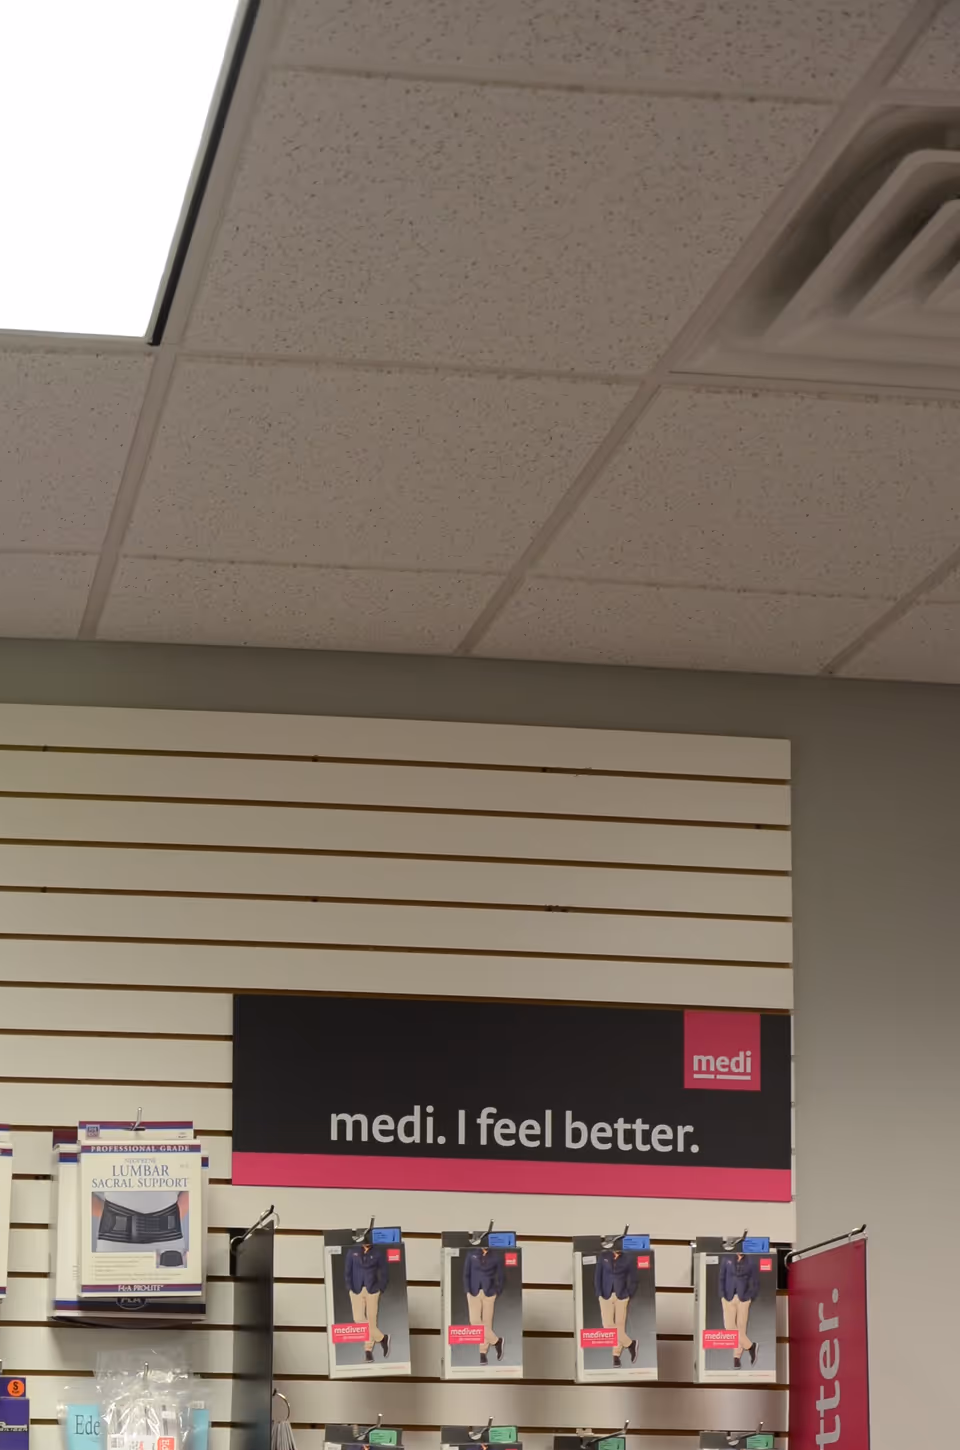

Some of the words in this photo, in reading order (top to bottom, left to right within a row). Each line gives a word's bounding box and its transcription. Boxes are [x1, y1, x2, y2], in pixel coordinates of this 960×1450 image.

[692, 1050, 753, 1075] medi
[329, 1105, 446, 1145] medi.
[458, 1109, 466, 1144] I
[477, 1107, 552, 1148] feel
[565, 1110, 700, 1154] better.
[112, 1165, 169, 1177] LUMBAR
[92, 1178, 134, 1188] SACRAL
[137, 1177, 188, 1188] SUPPORT
[13, 1381, 18, 1390] S
